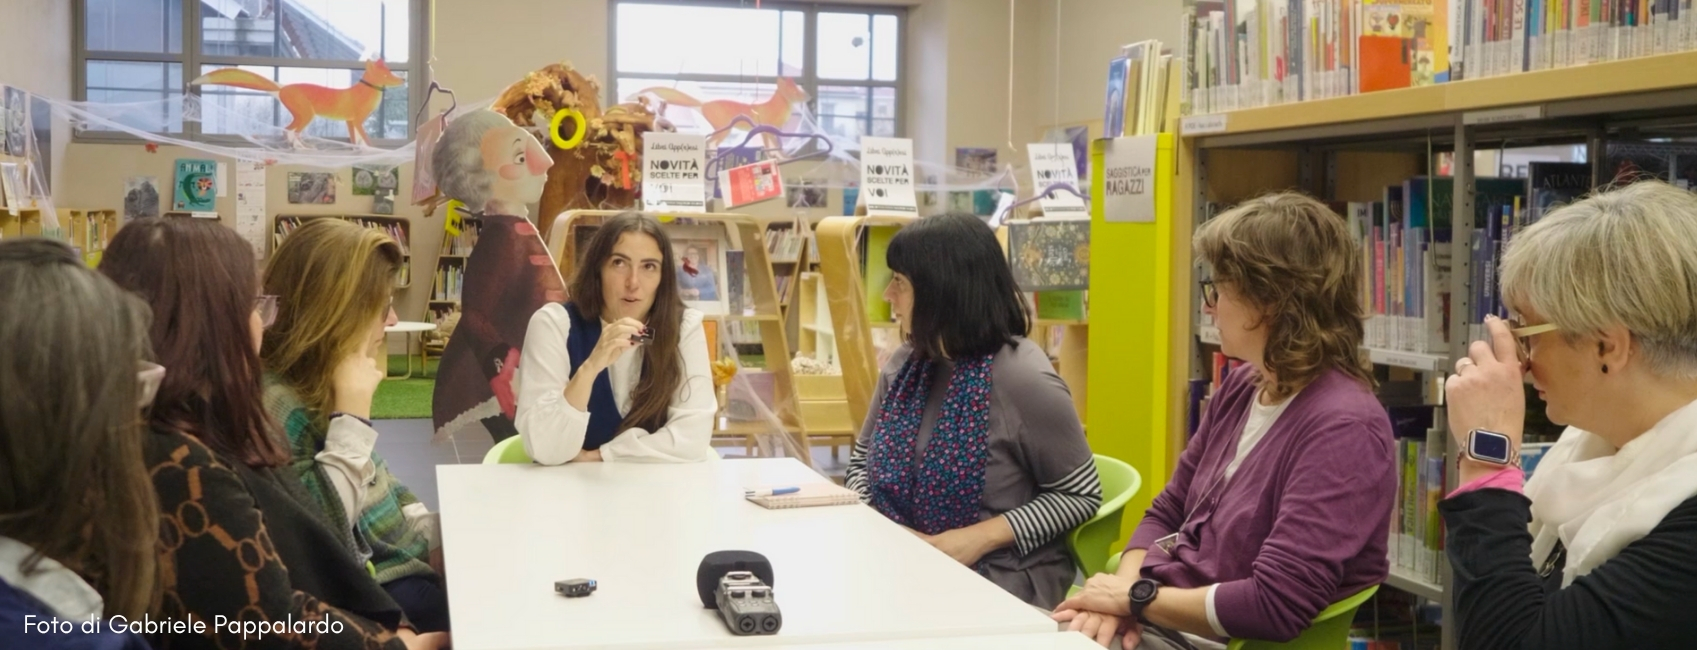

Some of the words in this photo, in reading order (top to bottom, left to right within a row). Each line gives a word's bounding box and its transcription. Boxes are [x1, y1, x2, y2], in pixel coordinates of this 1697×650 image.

[650, 158, 699, 171] NOVITÀ
[866, 164, 909, 176] NOVITÀ
[650, 171, 680, 180] SCELTE
[682, 172, 699, 180] PER
[1037, 167, 1074, 179] NOVITÀ
[1106, 166, 1141, 179] SAGGISTICA
[866, 177, 893, 185] SCELTE
[1106, 178, 1144, 196] RAGAZZI
[867, 188, 888, 198] VOI
